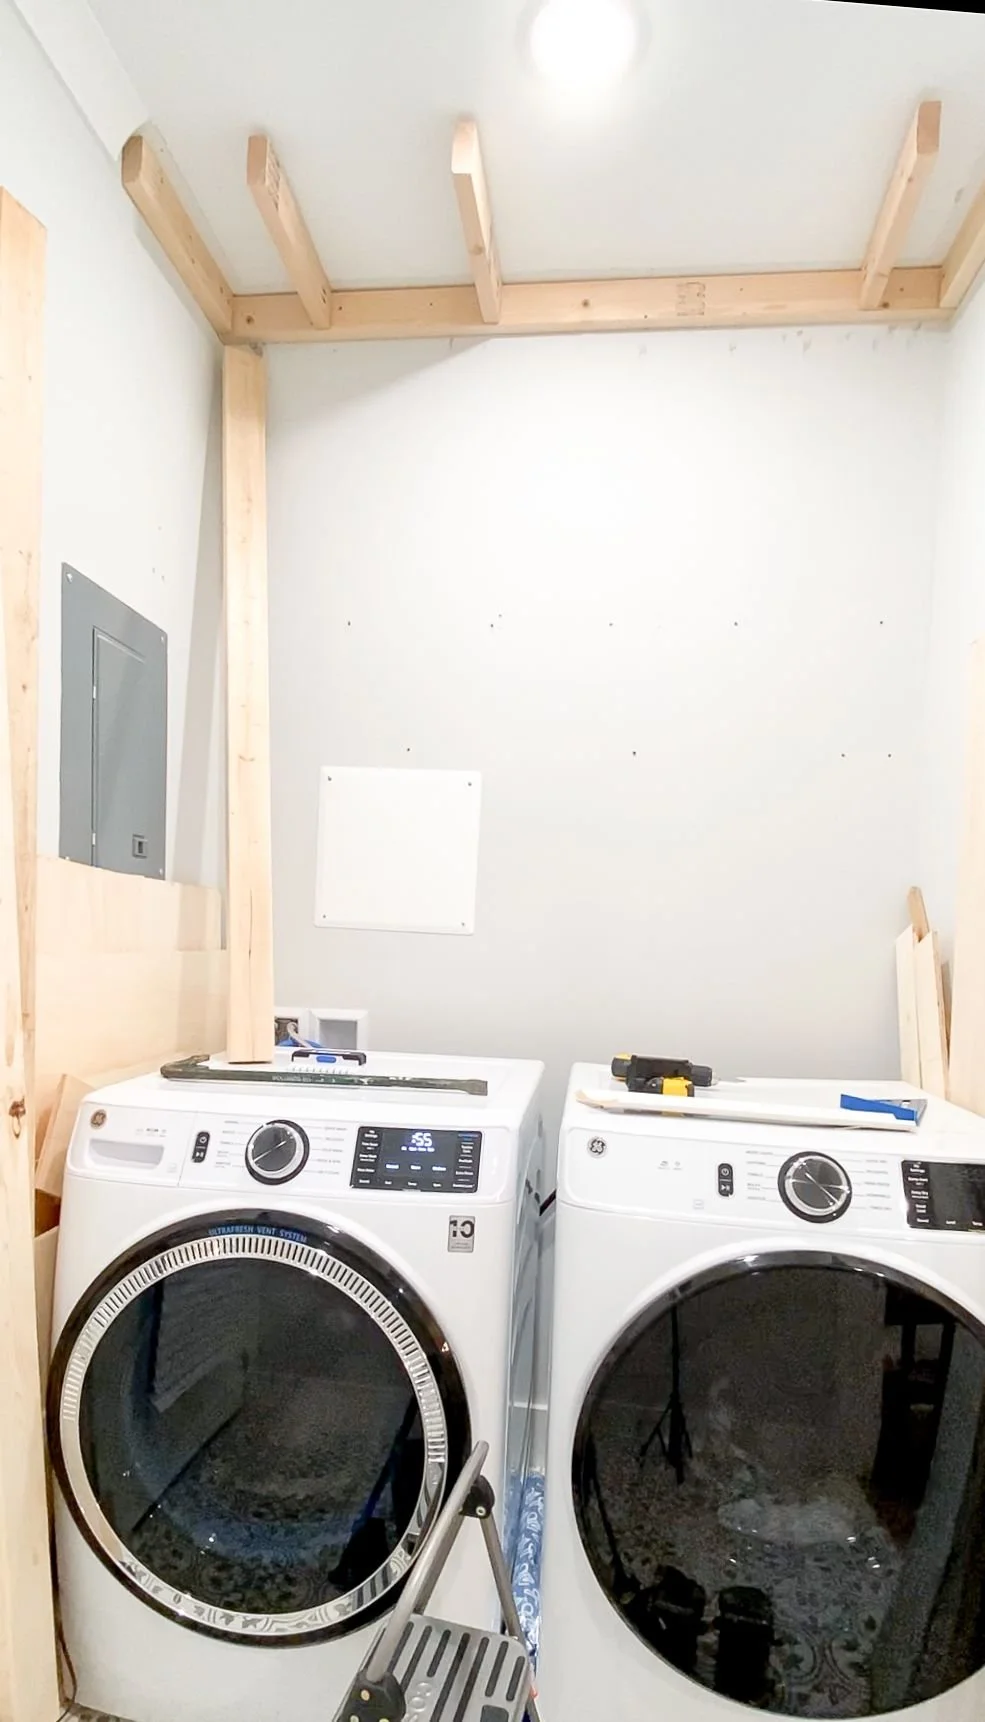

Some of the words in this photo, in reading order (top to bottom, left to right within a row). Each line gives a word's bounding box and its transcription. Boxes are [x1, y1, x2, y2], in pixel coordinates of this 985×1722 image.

[208, 1225, 254, 1236] ULTRAFRESH
[257, 1226, 276, 1235] VENT
[279, 1229, 308, 1243] SYSTEM
[450, 1220, 475, 1239] 10
